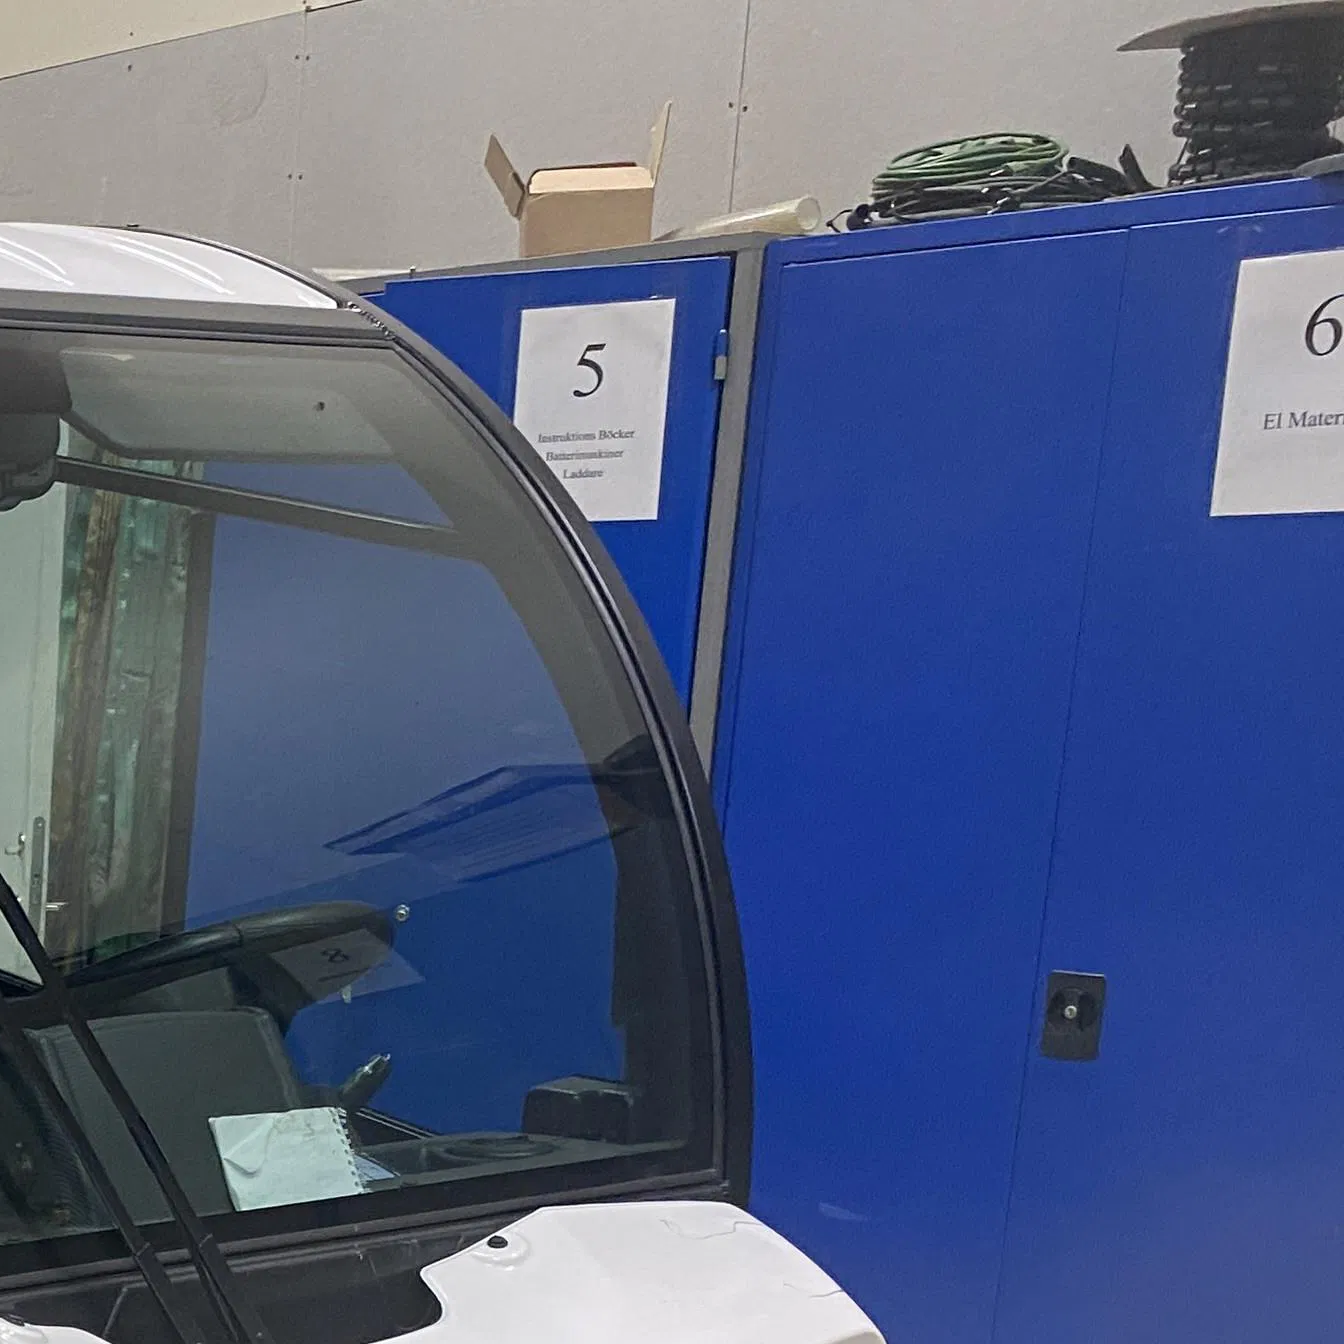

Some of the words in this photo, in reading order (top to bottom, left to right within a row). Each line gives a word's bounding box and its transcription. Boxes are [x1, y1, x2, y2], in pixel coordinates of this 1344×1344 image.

[1305, 294, 1344, 357] 6
[573, 343, 607, 398] 5
[1264, 412, 1282, 430] El
